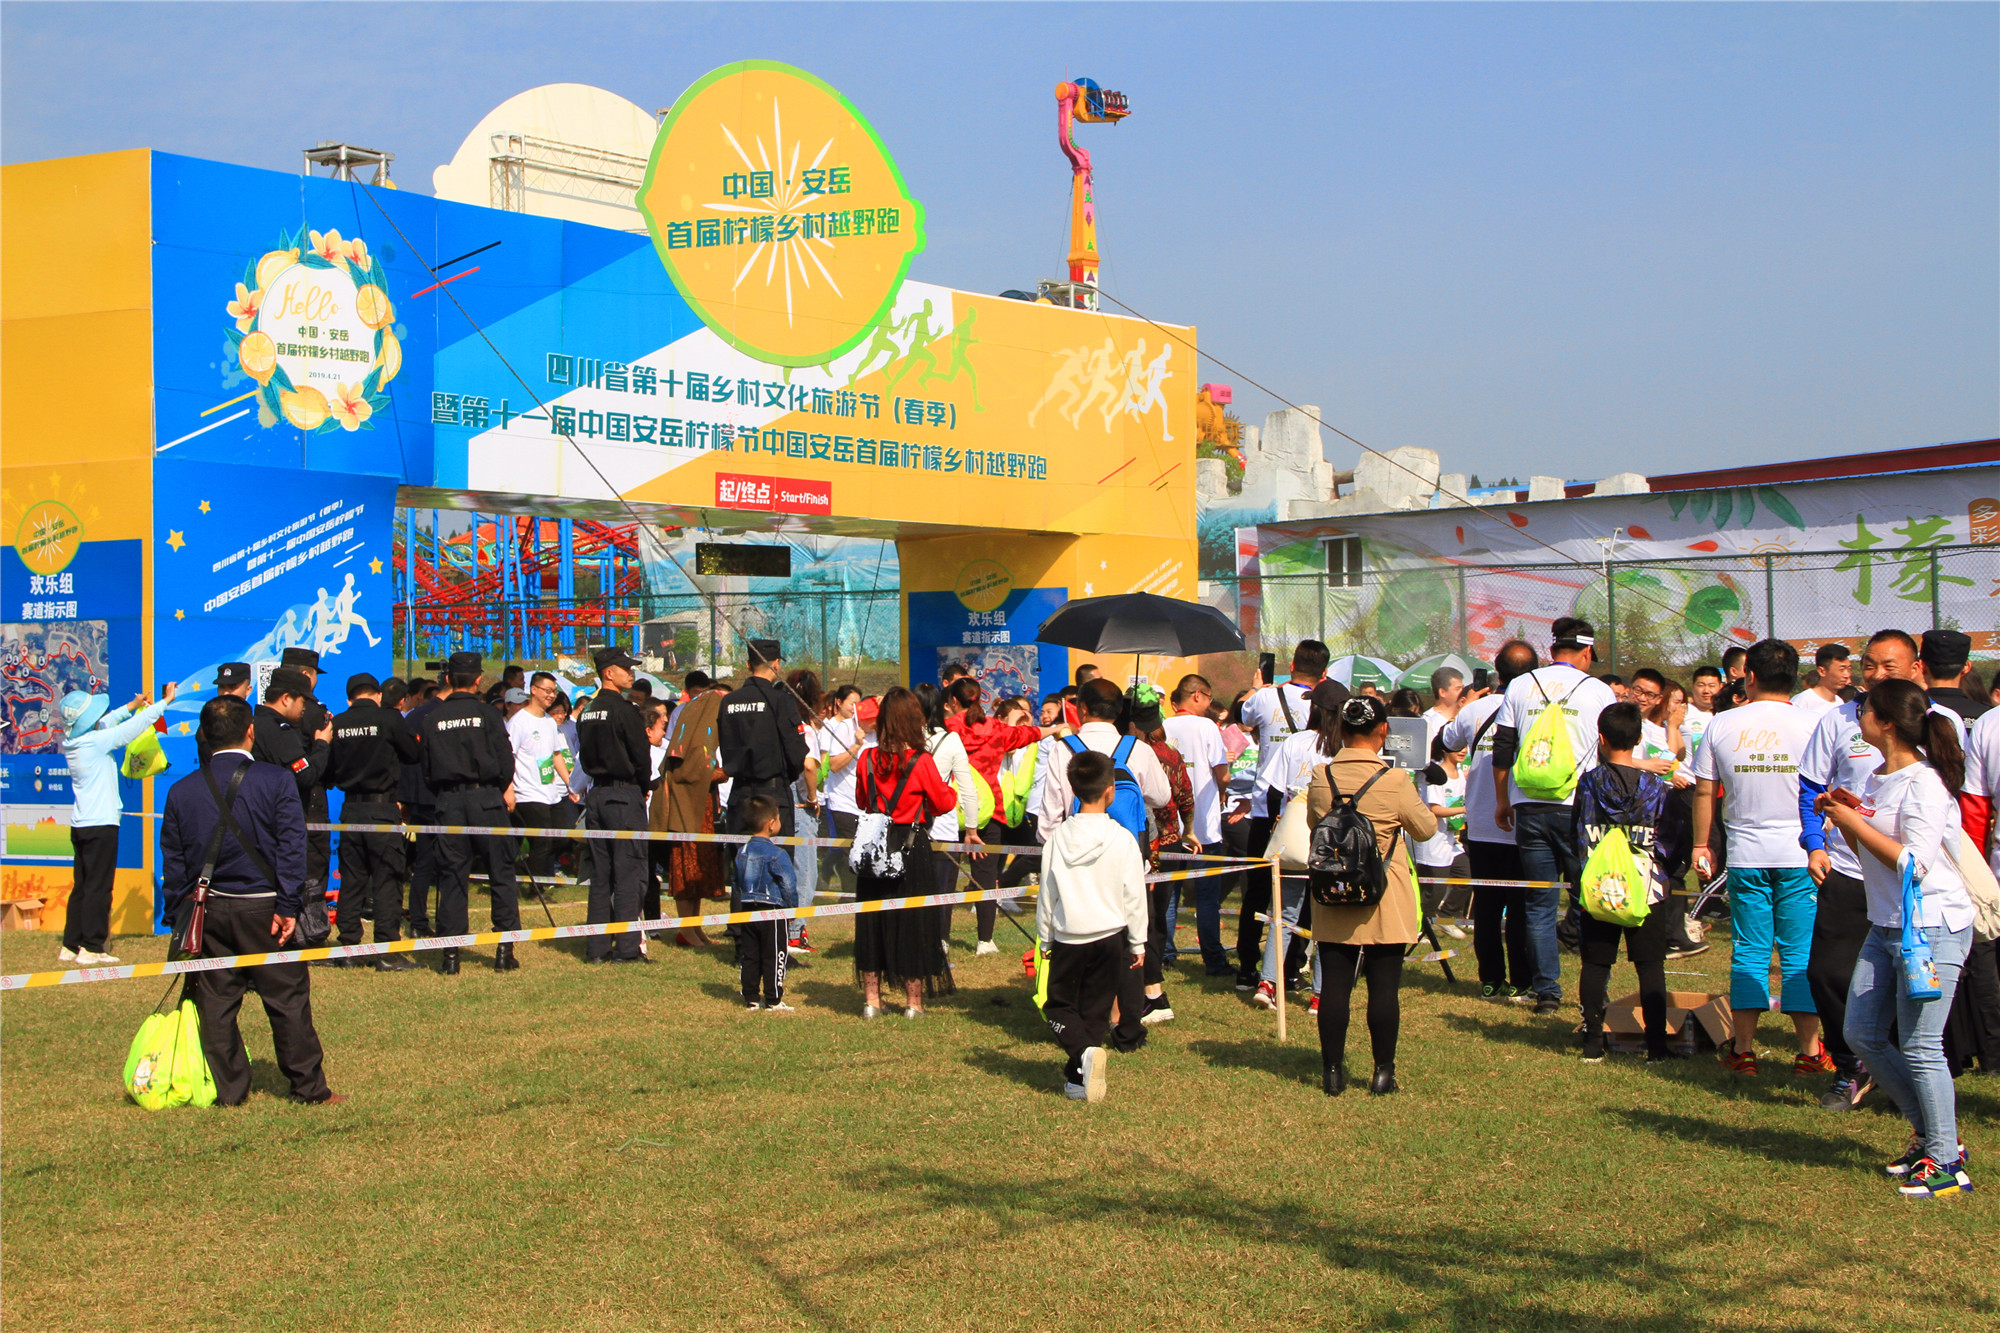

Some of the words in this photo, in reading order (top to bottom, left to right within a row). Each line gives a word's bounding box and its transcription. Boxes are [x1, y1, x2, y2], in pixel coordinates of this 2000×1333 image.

[667, 207, 899, 249] 首届柠檬乡村越野跑
[274, 281, 343, 321] Hello
[276, 343, 370, 363] 首届柠檬乡村越野跑
[308, 371, 341, 380] 2019.4.21
[546, 352, 957, 429] 四川省第十届乡村文化旅游节（春季）
[431, 391, 1047, 480] 暨第十一届中国安岳柠檬节中国安岳首届柠檬乡村越野跑
[781, 491, 829, 505] Start/Finish
[204, 527, 354, 612] 中国安岳首届柠檬乡村越野跑
[30, 572, 74, 595] 欢乐组
[22, 600, 78, 620] 赛道指示图
[968, 611, 1006, 627] 欢乐组
[962, 630, 1010, 644] 赛道指示图
[727, 702, 765, 714] 特SWAT警
[437, 717, 481, 731] 特SWAT警
[338, 726, 378, 738] 特SWAT警
[1733, 728, 1782, 752] Hello
[1734, 765, 1799, 773] 首届柠檬乡村越野
[988, 887, 1020, 898] LIMITLINE
[820, 904, 856, 915] LIMITLINE
[634, 918, 673, 930] LIMITLINE
[422, 936, 468, 948] LIMITLINE
[173, 957, 226, 972] LIMITLINE
[80, 966, 120, 981] 警戒线
